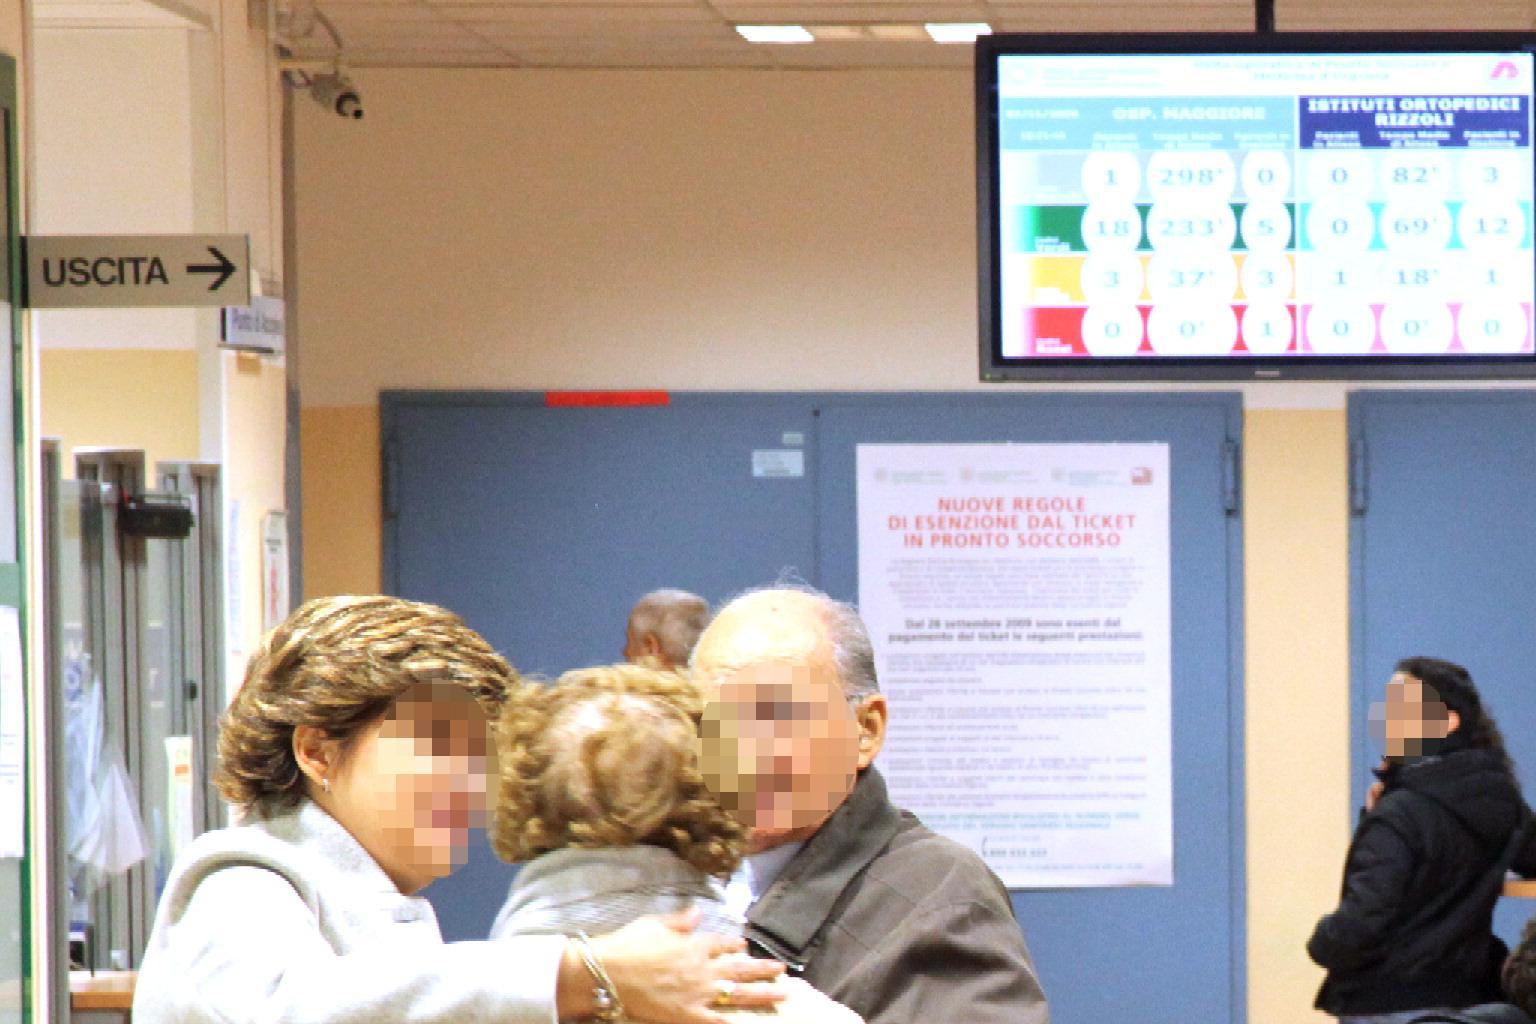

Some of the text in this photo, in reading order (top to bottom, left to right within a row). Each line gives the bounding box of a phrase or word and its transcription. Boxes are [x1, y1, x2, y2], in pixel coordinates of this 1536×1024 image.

[1308, 98, 1520, 111] ISTITUTI ORTOPEDICI
[1375, 113, 1454, 126] RIZZOLI
[1107, 169, 1117, 184] 1
[1258, 168, 1274, 184] 0
[1332, 167, 1348, 183] 0
[1484, 166, 1499, 183] 3
[1097, 219, 1129, 235] 18
[1332, 218, 1348, 234] 0
[1477, 217, 1508, 234] 12
[43, 257, 169, 287] USCITA
[1105, 322, 1121, 338] 0
[1333, 320, 1349, 336] 0
[1484, 320, 1500, 336] 0
[937, 496, 1086, 513] NUOVE REGOLE
[887, 514, 1136, 531] DI ESENZIONE DAL TICKET
[903, 532, 1122, 549] IN PRONTO SOCCORSO
